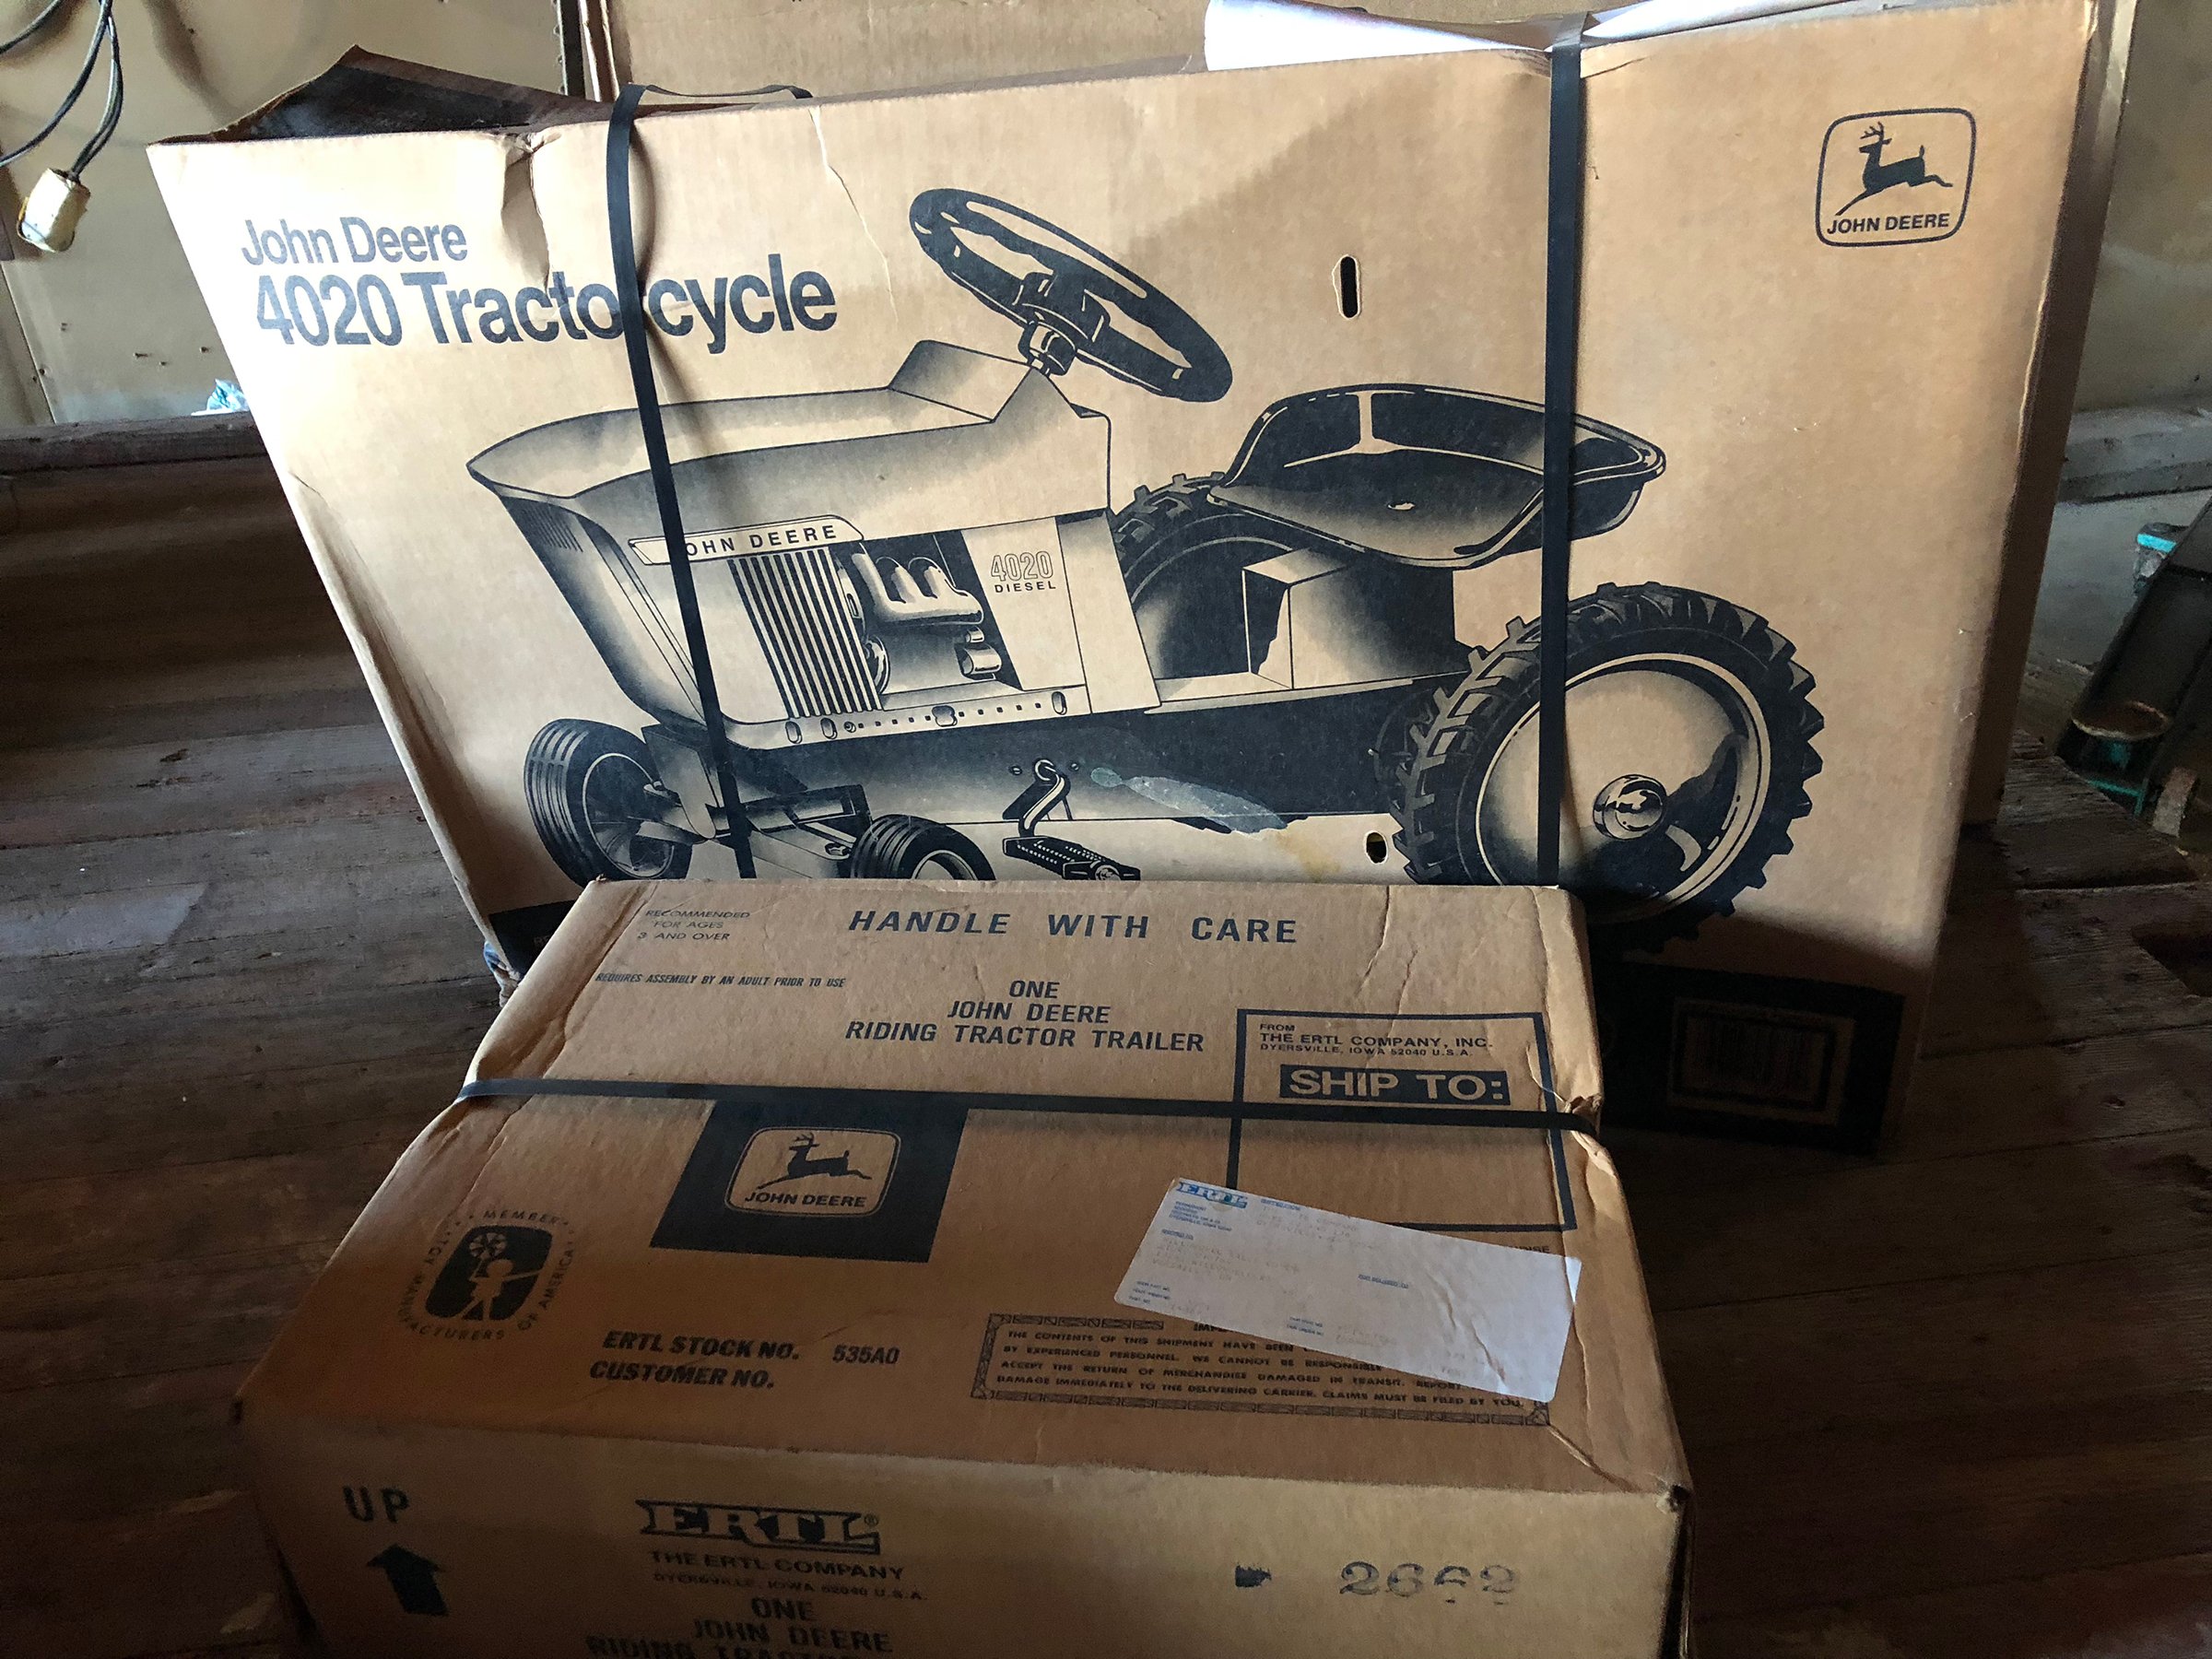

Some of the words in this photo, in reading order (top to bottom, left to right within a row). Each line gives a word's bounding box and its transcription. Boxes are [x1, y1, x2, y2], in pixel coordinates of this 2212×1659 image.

[1827, 218, 1880, 234] JOHN
[1885, 213, 1950, 230] DEERE
[242, 218, 339, 265] John
[341, 217, 467, 263] Deere
[256, 274, 403, 347] 4020
[401, 253, 838, 355] Tractocycle
[685, 536, 735, 556] OHN
[749, 525, 837, 549] DEERE
[991, 550, 1053, 582] 4020
[994, 581, 1056, 593] DIESEL
[645, 910, 750, 919] RECOMMENDED
[653, 921, 680, 929] FOR
[688, 921, 724, 929] AGES
[848, 910, 1012, 935] HANDLE
[1048, 913, 1149, 938] WITH
[1191, 916, 1298, 943] CARE
[654, 932, 686, 940] AND
[692, 933, 730, 941] OVER
[595, 972, 642, 982] REQUIRES
[646, 973, 697, 983] ASSEMBLY
[701, 975, 716, 984] BY
[719, 975, 735, 985] AN
[738, 976, 770, 986] ADULT
[774, 977, 804, 987] PRIOR
[809, 977, 821, 987] TO
[827, 978, 846, 988] USE
[1008, 980, 1060, 999] ONE
[947, 1001, 1011, 1020] JOHN
[1026, 1004, 1112, 1024] DEERE
[845, 1021, 937, 1041] RIDING
[954, 1024, 1076, 1047] TRACTOR
[1092, 1030, 1205, 1053] TRAILER
[1260, 1023, 1295, 1032] FROM
[1260, 1033, 1293, 1043] THE
[1300, 1034, 1342, 1045] ERTL
[1350, 1036, 1448, 1049] COMPANY,
[1455, 1038, 1492, 1048] INC.
[1349, 1046, 1385, 1055] IOWA
[1391, 1048, 1427, 1056] 52040
[1289, 1069, 1399, 1097] SHIP
[1416, 1075, 1504, 1100] TO:
[745, 1192, 798, 1205] JOHN
[802, 1194, 867, 1207] DEERE
[602, 1330, 664, 1353] ERTL
[669, 1335, 752, 1359] STOCK
[757, 1341, 800, 1360] NO.
[1035, 1332, 1094, 1342] CONTENTS
[1124, 1336, 1149, 1345] THIS
[1157, 1337, 1214, 1348] SHIPMENT
[1223, 1341, 1256, 1350] HAVE
[1001, 1360, 1043, 1370] ACCEPT
[1053, 1363, 1073, 1371] THE
[1083, 1365, 1128, 1374] RETURN
[1258, 1373, 1320, 1382] DAMAGED
[1330, 1376, 1344, 1384] IN
[1218, 1356, 1271, 1366] CANNOT
[590, 1359, 728, 1387] CUSTOMER
[730, 1370, 774, 1390] NO.
[996, 1375, 1050, 1385] DAMAGE
[1140, 1382, 1156, 1391] TO
[1161, 1383, 1182, 1392] THE
[1323, 1390, 1368, 1400] CLAIMS
[1374, 1394, 1407, 1402] MUST
[1413, 1394, 1427, 1403] BE
[342, 1485, 411, 1524] UP
[635, 1500, 881, 1555] ERTL
[650, 1550, 696, 1566] THE
[705, 1554, 767, 1571] ERTL
[774, 1558, 906, 1580] COMPANY
[751, 1596, 813, 1621] ONE
[694, 1619, 771, 1643] JOHN
[788, 1625, 893, 1653] DEERE
